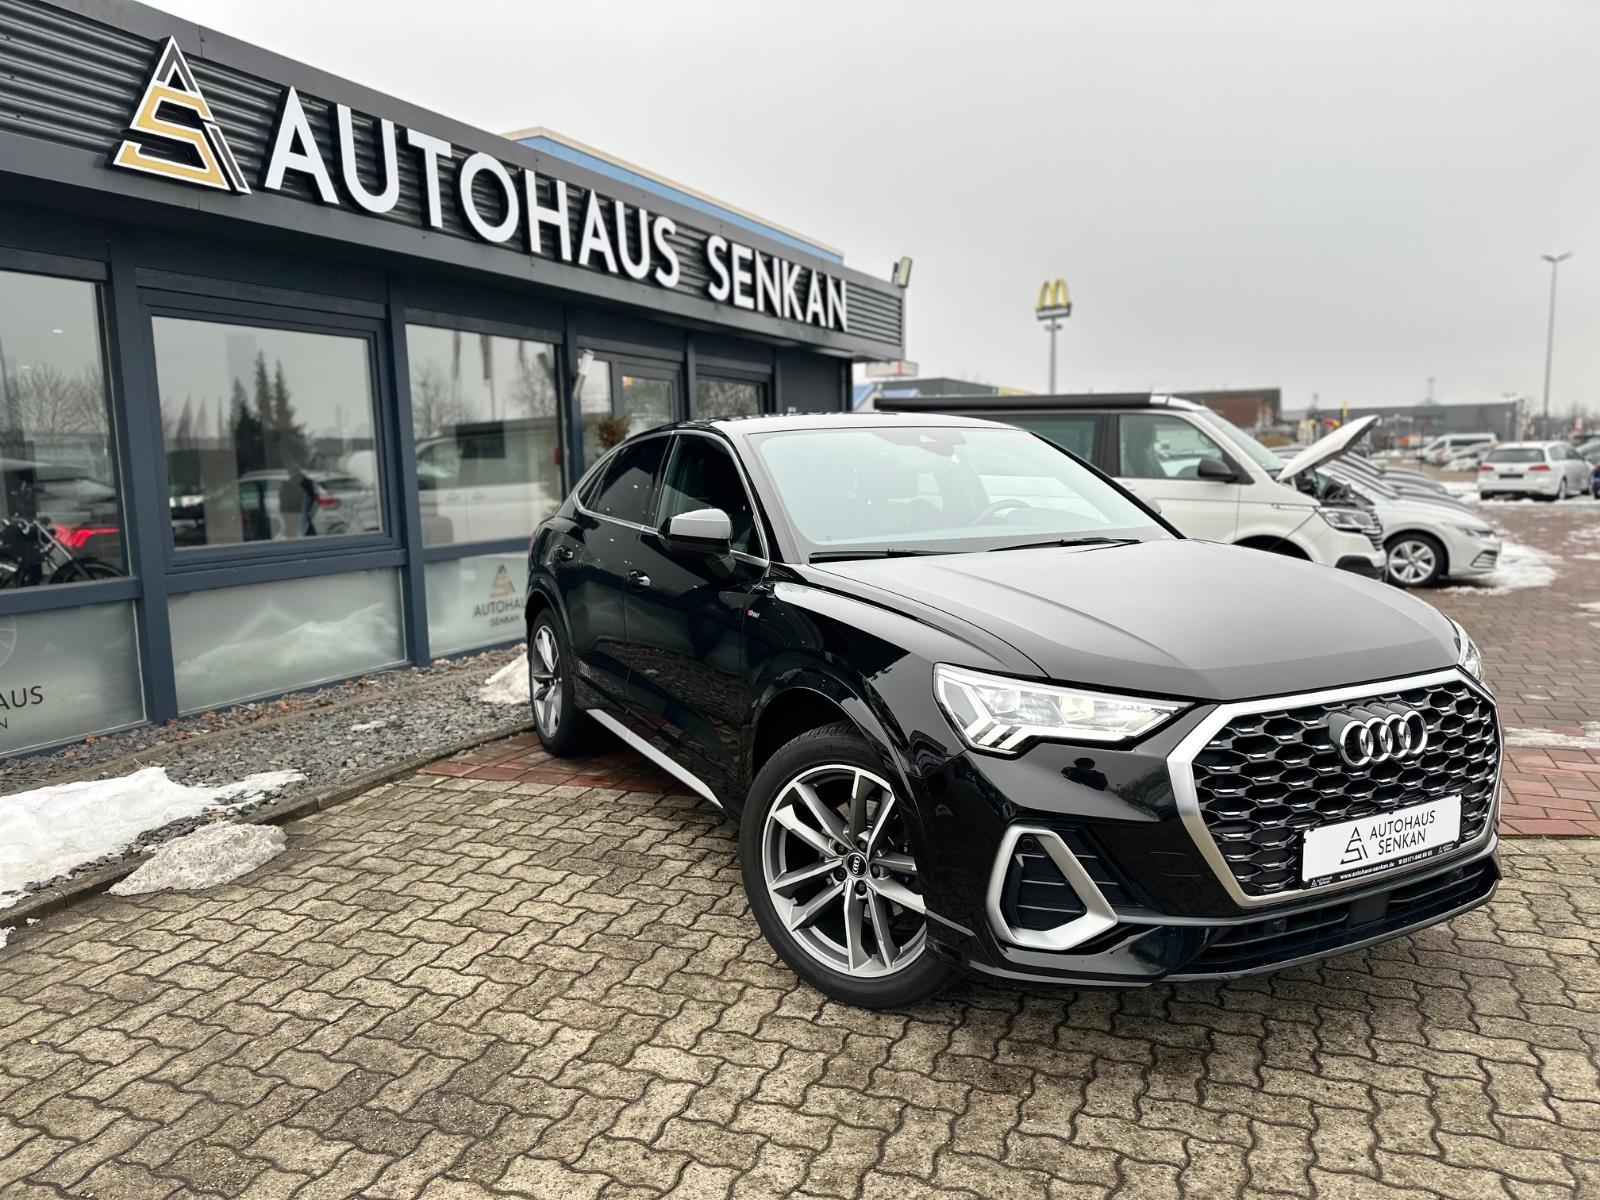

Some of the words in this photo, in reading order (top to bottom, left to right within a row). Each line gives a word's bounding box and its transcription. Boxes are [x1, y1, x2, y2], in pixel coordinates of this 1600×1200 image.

[264, 86, 680, 288] AUTOHAUS
[706, 235, 848, 332] SENKAN
[1369, 810, 1436, 840] AUTOHAUS
[1378, 828, 1426, 855] SENKAN
